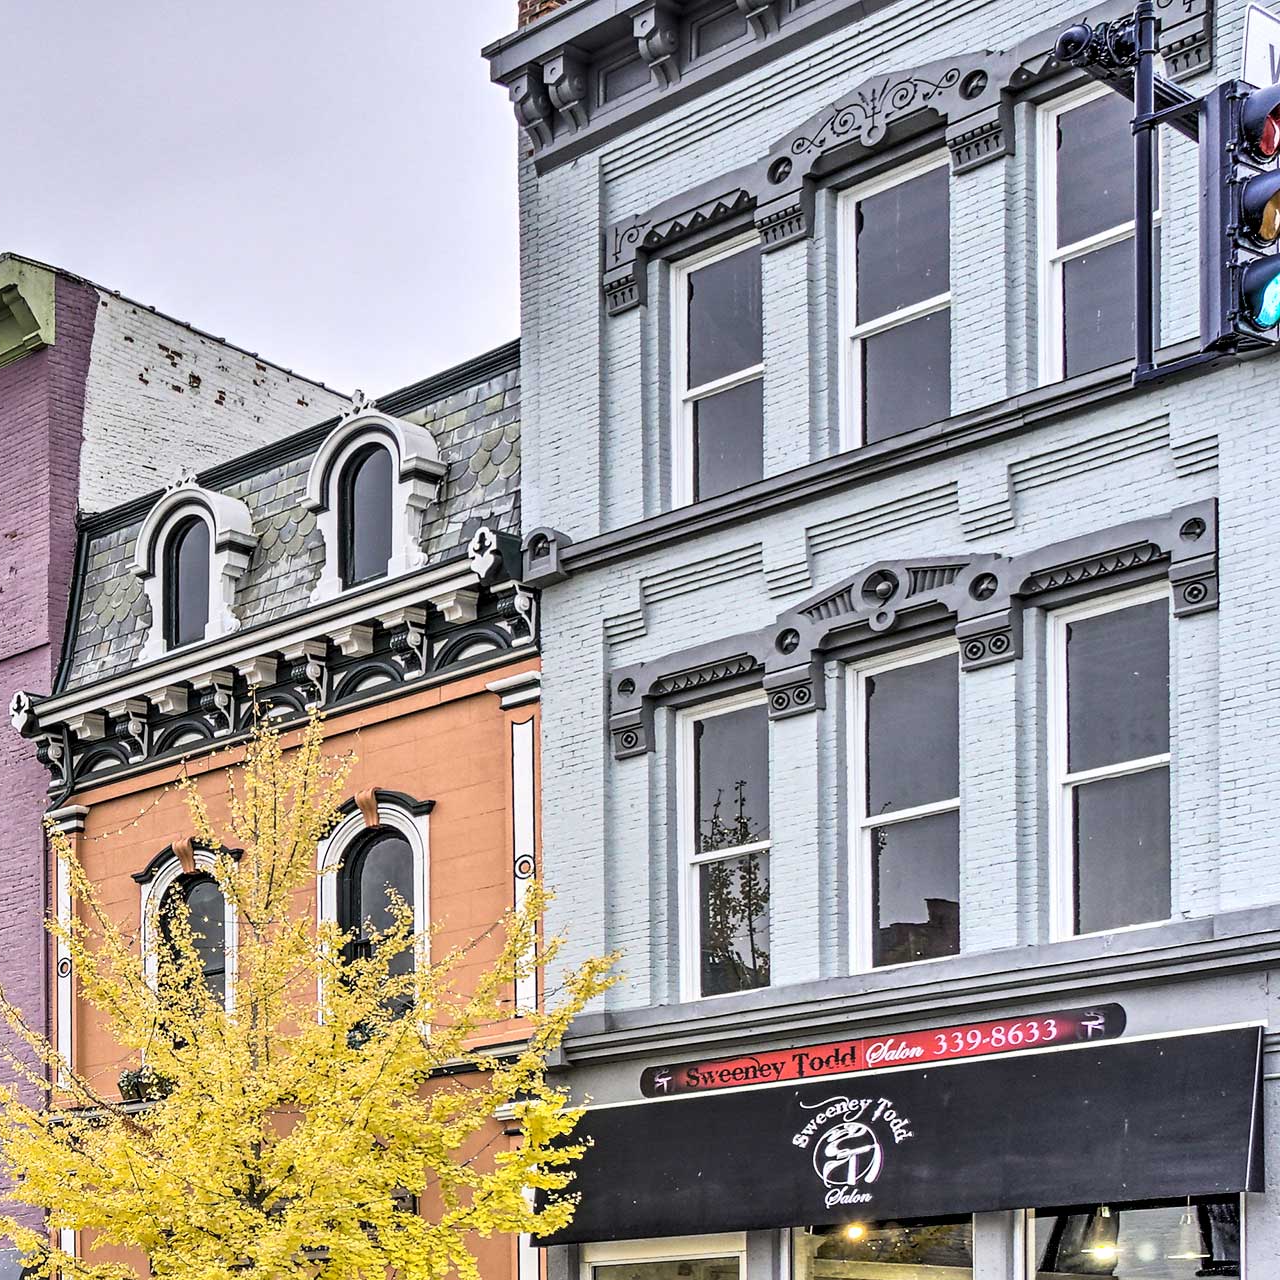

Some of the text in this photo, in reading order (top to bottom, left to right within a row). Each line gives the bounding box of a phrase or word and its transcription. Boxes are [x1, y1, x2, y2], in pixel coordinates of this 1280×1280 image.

[686, 1019, 1058, 1088] Sweeney Todd Salon 339-8633
[792, 1096, 913, 1148] Sweeney Todd
[824, 1186, 873, 1209] Salon
